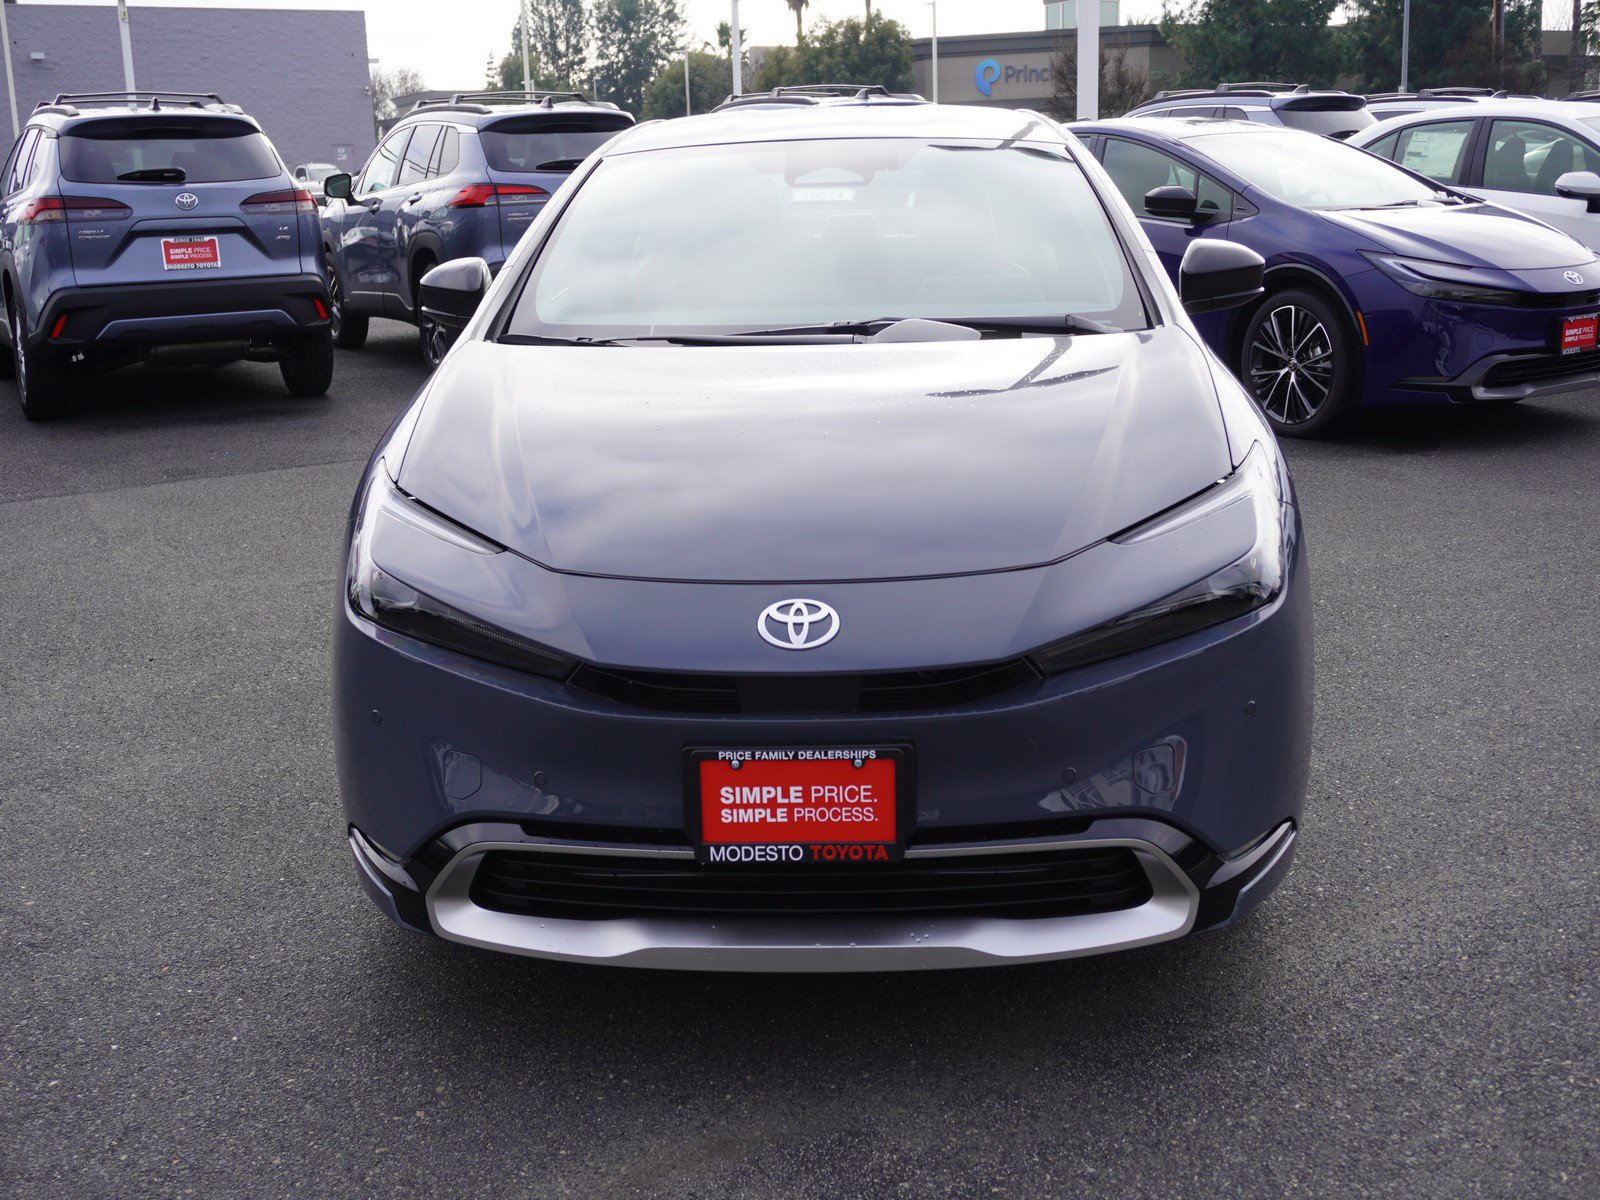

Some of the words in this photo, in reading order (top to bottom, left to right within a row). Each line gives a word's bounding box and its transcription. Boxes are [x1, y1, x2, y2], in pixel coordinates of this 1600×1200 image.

[1004, 64, 1054, 83] Princi
[718, 751, 752, 761] PRICE
[755, 751, 795, 760] FAMILY
[798, 750, 877, 760] DEALERSHIPS
[719, 786, 804, 804] SIMPLE
[810, 785, 878, 803] PRICE.
[720, 808, 789, 823] SIMPLE
[793, 807, 879, 822] PROCESS.
[709, 845, 804, 862] MODESTO
[809, 844, 889, 861] TOYOTA
